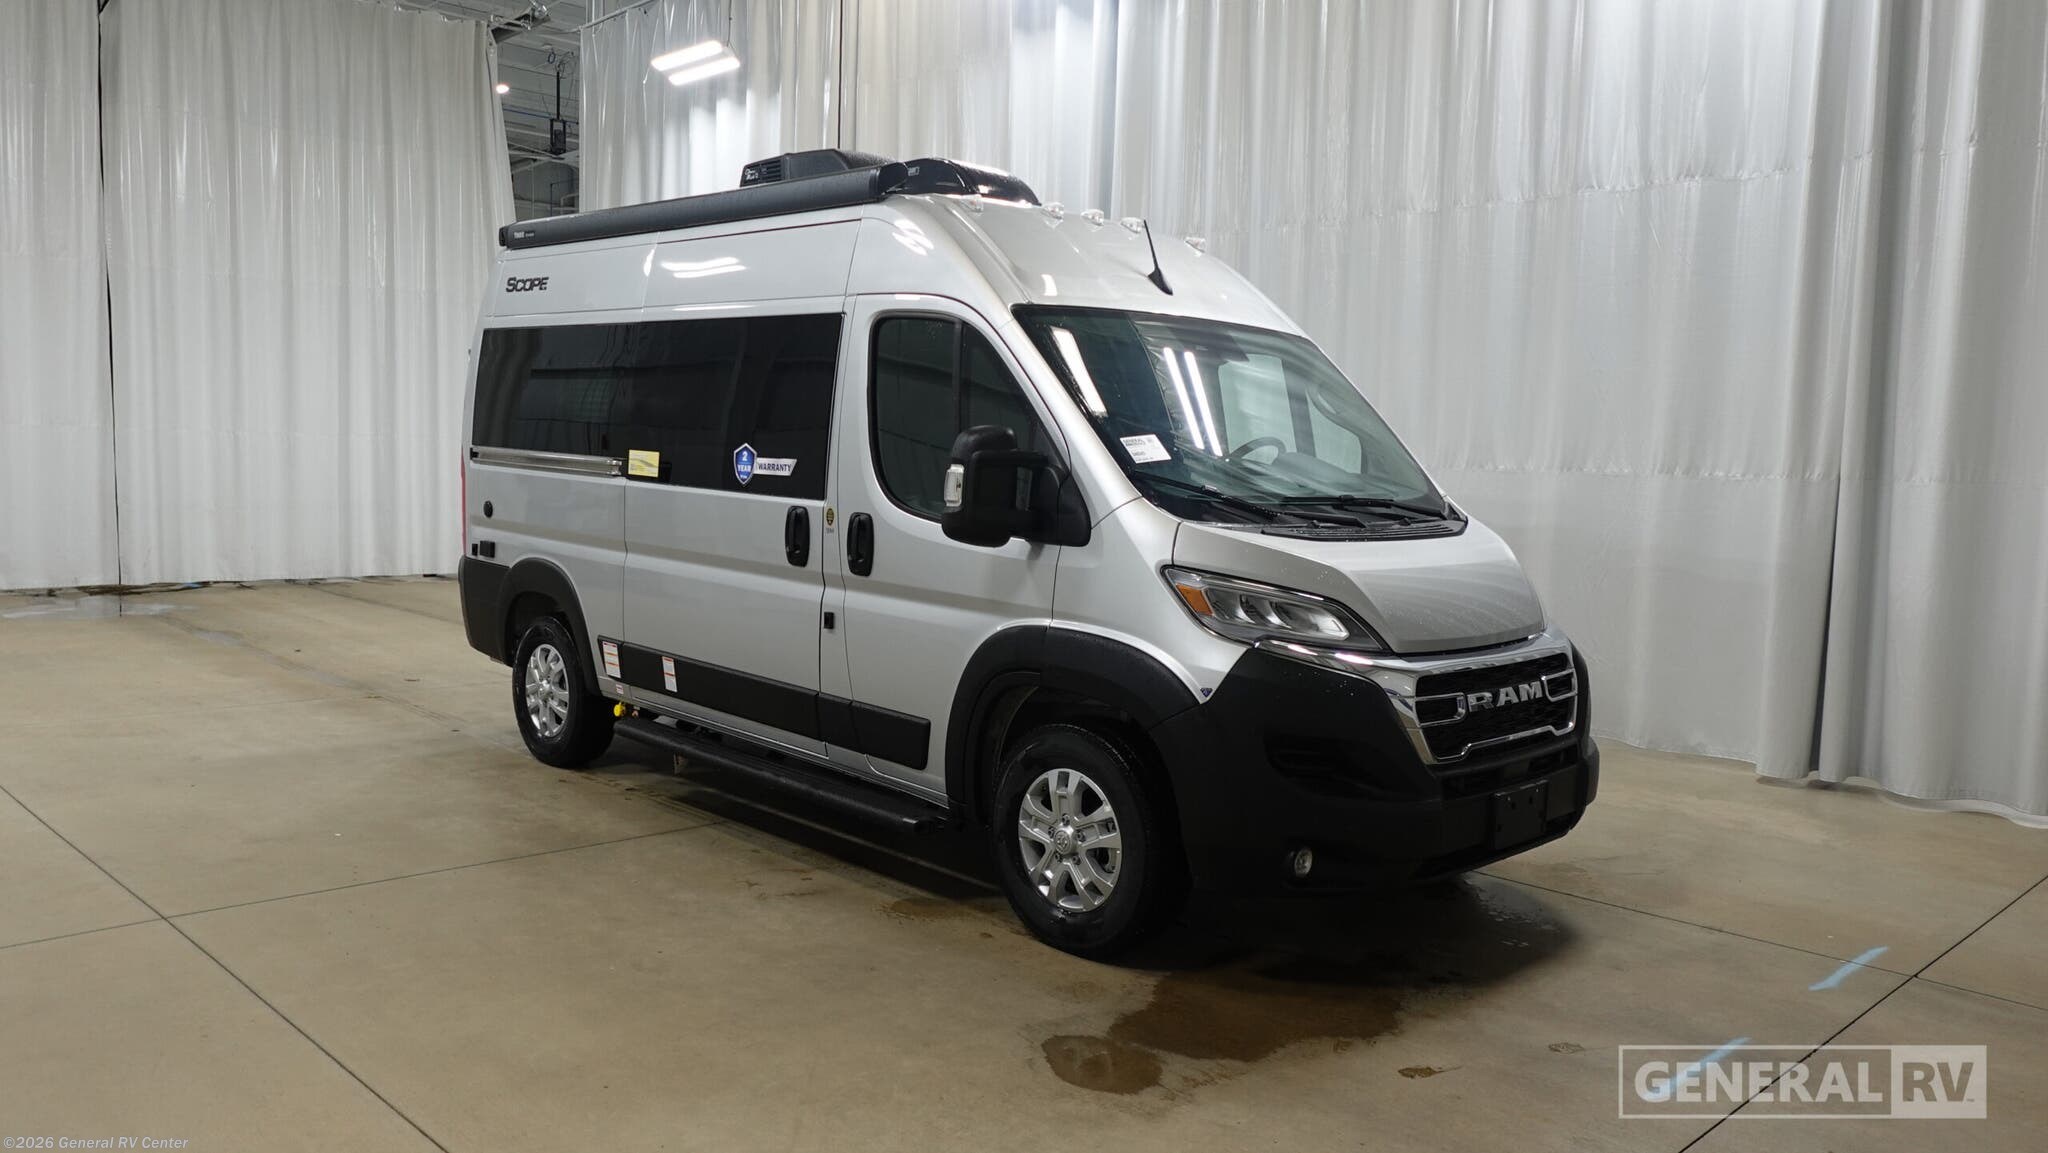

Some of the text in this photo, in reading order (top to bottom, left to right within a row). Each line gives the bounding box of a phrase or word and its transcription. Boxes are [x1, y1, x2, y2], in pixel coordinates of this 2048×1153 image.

[742, 450, 748, 461] 2
[758, 462, 791, 472] WARRANTY
[1467, 681, 1543, 712] RAM
